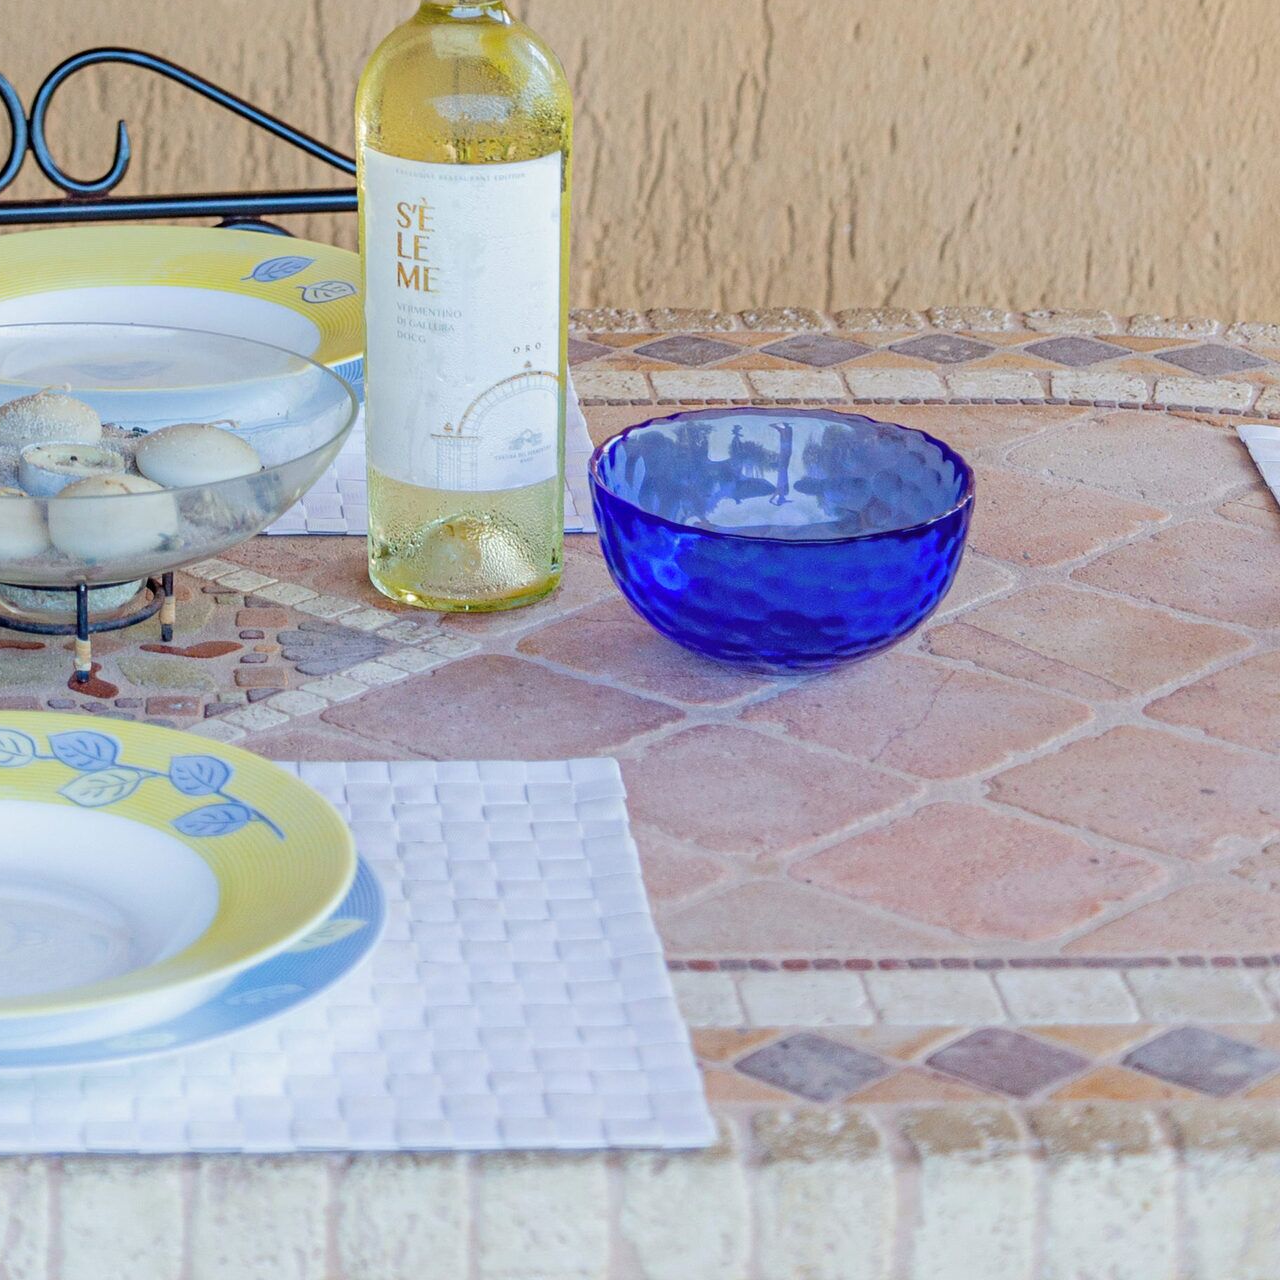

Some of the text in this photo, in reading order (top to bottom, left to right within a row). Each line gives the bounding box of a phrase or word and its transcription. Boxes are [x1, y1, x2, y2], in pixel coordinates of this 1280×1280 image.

[397, 231, 430, 262] LE
[397, 261, 440, 293] ME
[396, 301, 462, 319] VERMENTINO
[396, 316, 456, 333] DI GALLURA
